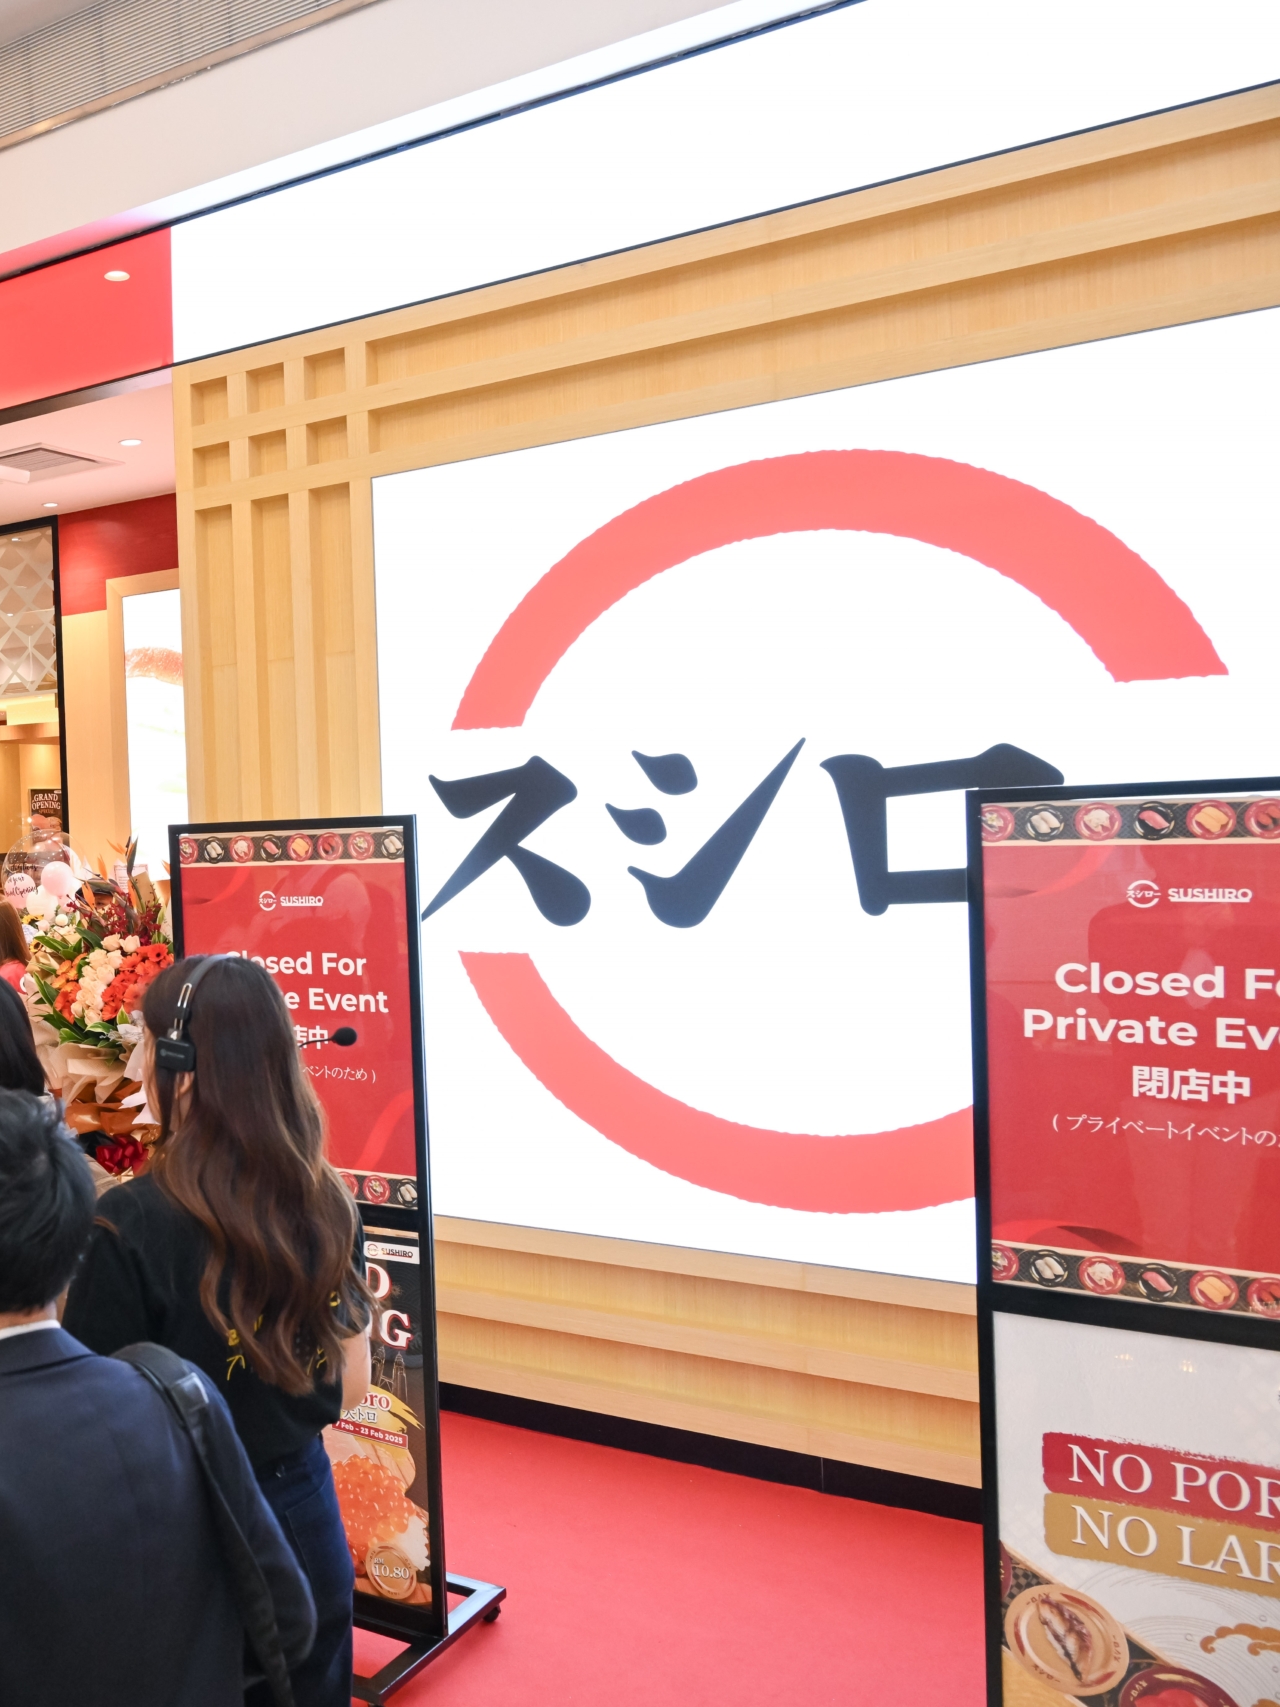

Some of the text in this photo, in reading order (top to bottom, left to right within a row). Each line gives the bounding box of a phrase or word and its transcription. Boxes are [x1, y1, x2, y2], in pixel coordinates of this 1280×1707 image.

[31, 800, 61, 811] OPENING
[33, 793, 58, 802] GRAND
[421, 737, 1064, 928] スシロ
[280, 895, 324, 907] SUSHIRO
[1125, 890, 1161, 899] スシロー
[1167, 887, 1253, 903] SUSHIRO
[322, 952, 367, 976] For
[1055, 962, 1280, 1000] Closed F
[308, 987, 389, 1014] Event
[1023, 1007, 1198, 1047] Private
[1132, 1065, 1251, 1105] 閉店中
[381, 1247, 414, 1259] SUSHIRO
[341, 1421, 354, 1431] Feb
[360, 1426, 369, 1435] 23
[370, 1429, 383, 1439] Feb
[385, 1433, 403, 1444] 2025
[1068, 1443, 1153, 1494] NO
[1071, 1504, 1158, 1557] NO
[374, 1557, 384, 1565] RM
[374, 1564, 410, 1580] 10.80
